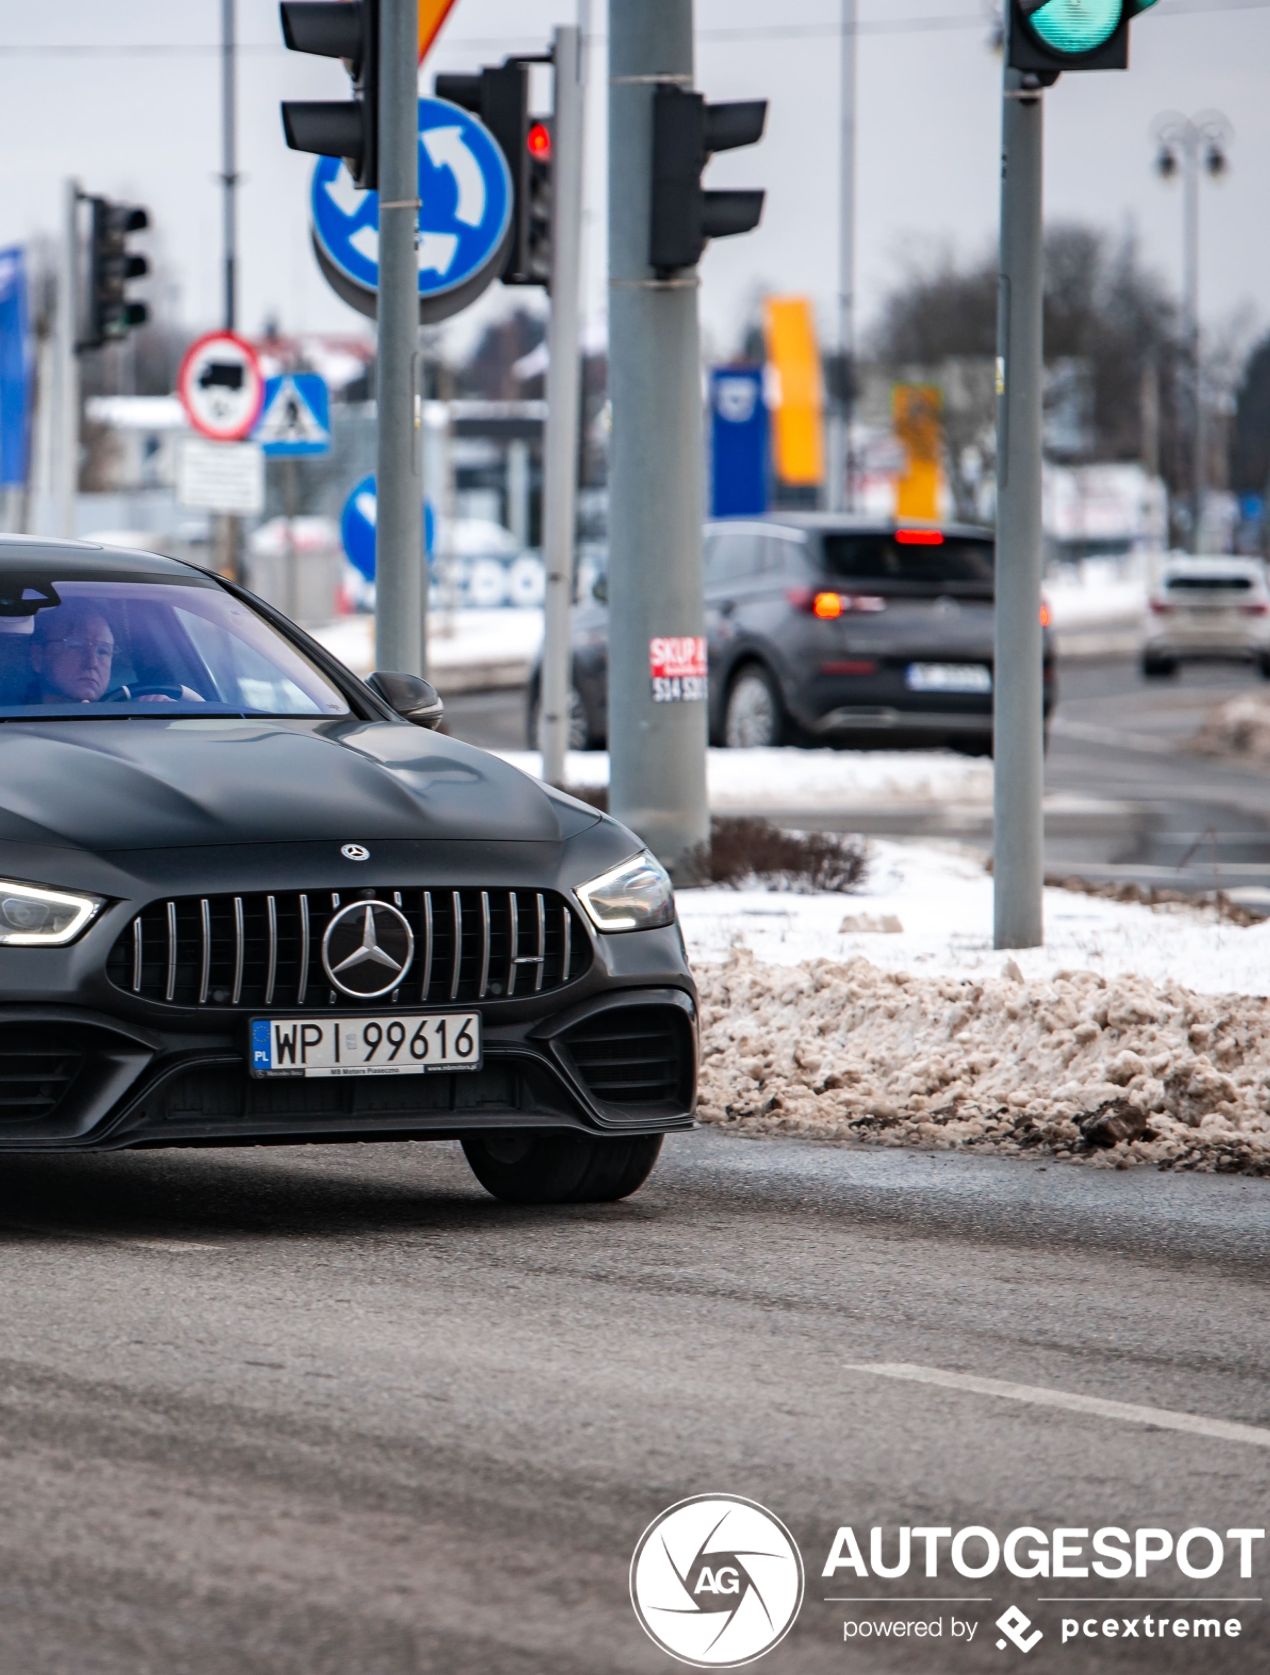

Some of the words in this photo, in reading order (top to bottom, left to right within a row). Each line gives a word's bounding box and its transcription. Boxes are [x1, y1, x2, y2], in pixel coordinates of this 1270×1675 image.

[254, 1050, 269, 1062] PL
[274, 1022, 340, 1065] WPI
[363, 1018, 473, 1062] 99616
